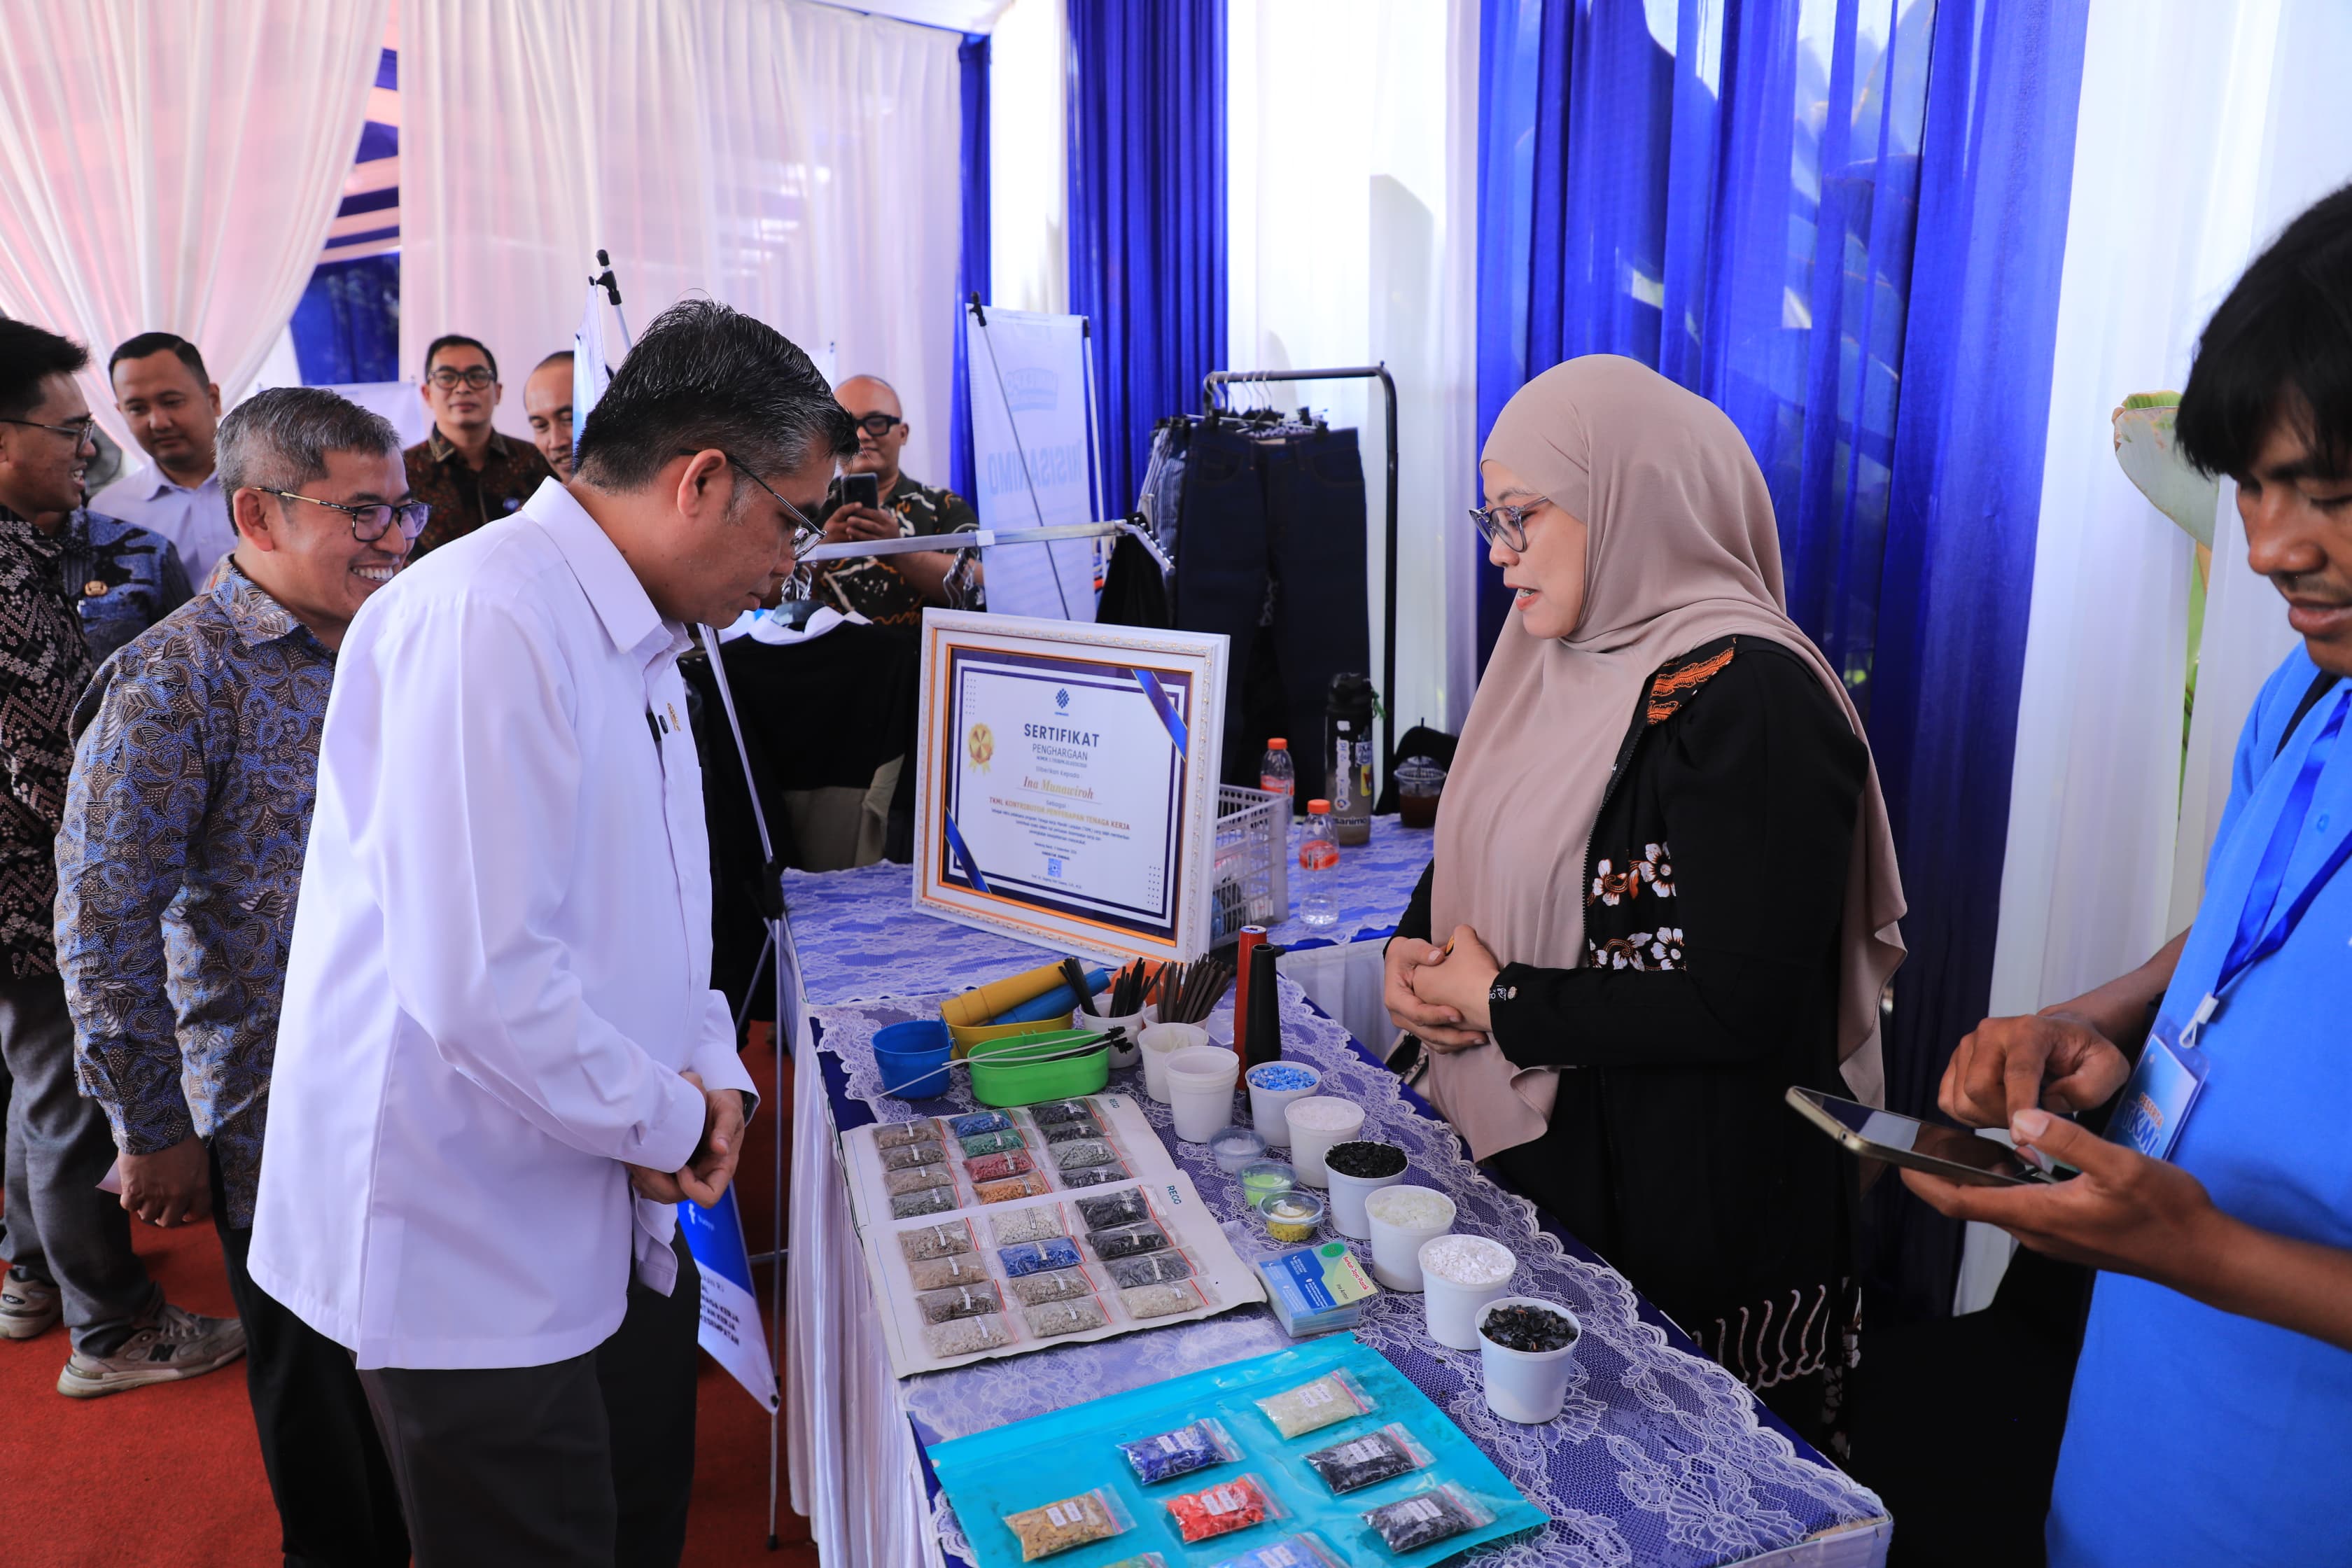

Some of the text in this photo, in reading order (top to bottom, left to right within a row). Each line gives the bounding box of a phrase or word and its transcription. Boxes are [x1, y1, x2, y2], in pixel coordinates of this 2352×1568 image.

[1024, 723, 1099, 748] SERTIFIKAT
[1032, 743, 1088, 761] PENGHARGAAN
[1023, 776, 1039, 789] Ina
[1111, 820, 1130, 831] KERJA
